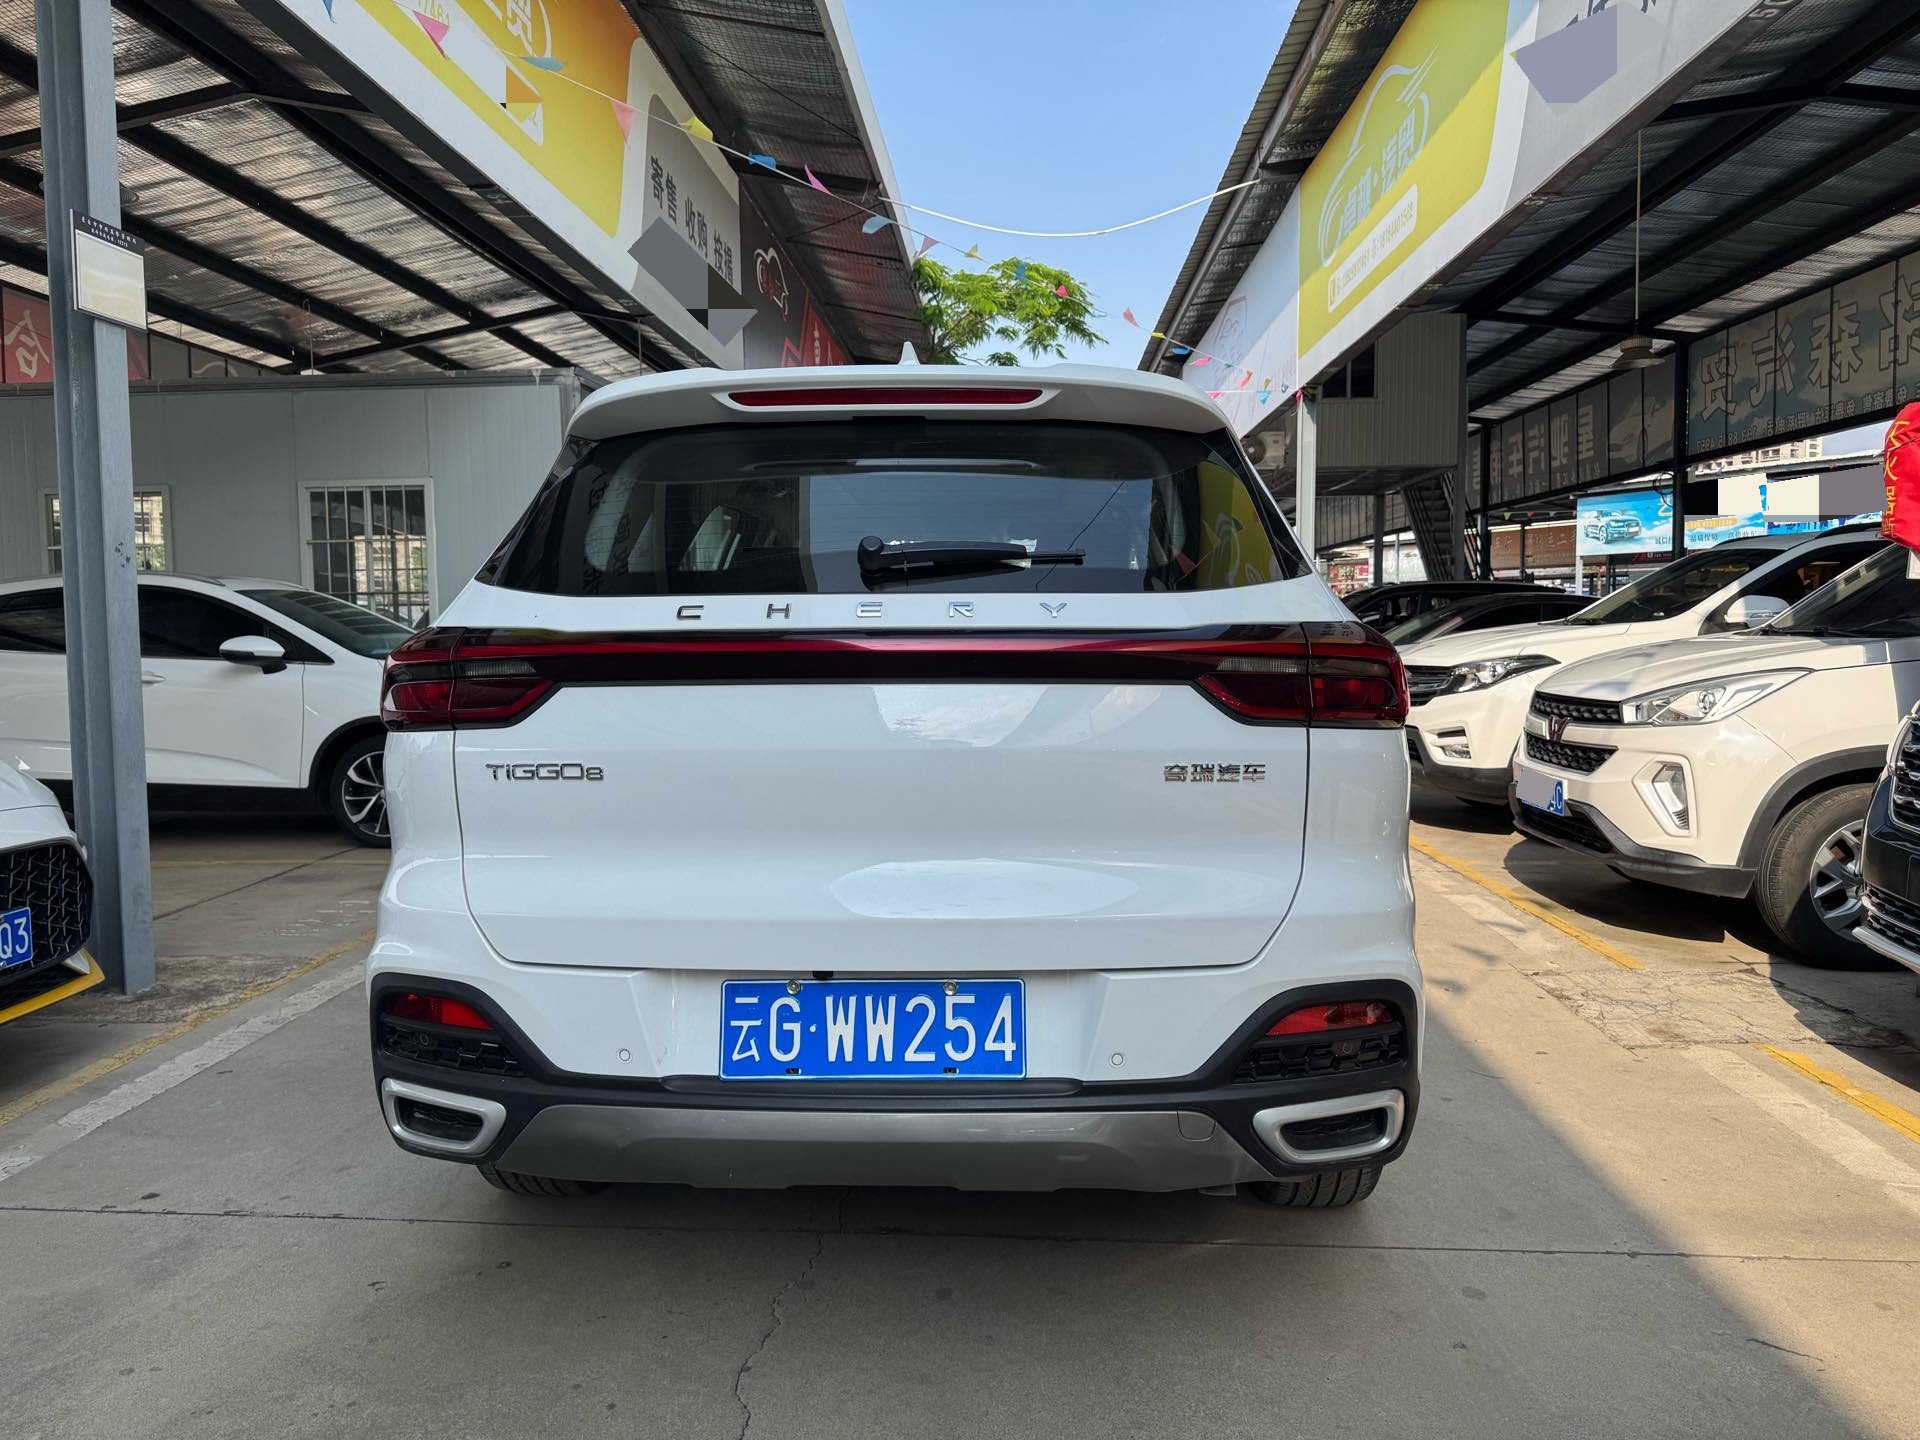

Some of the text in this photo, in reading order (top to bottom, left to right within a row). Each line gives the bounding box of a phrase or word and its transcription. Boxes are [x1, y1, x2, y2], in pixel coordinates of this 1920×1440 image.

[651, 155, 677, 224] 寄售
[685, 197, 708, 259] 收购
[676, 601, 1068, 620] CHERY
[1163, 764, 1266, 782] 奇瑞汽车
